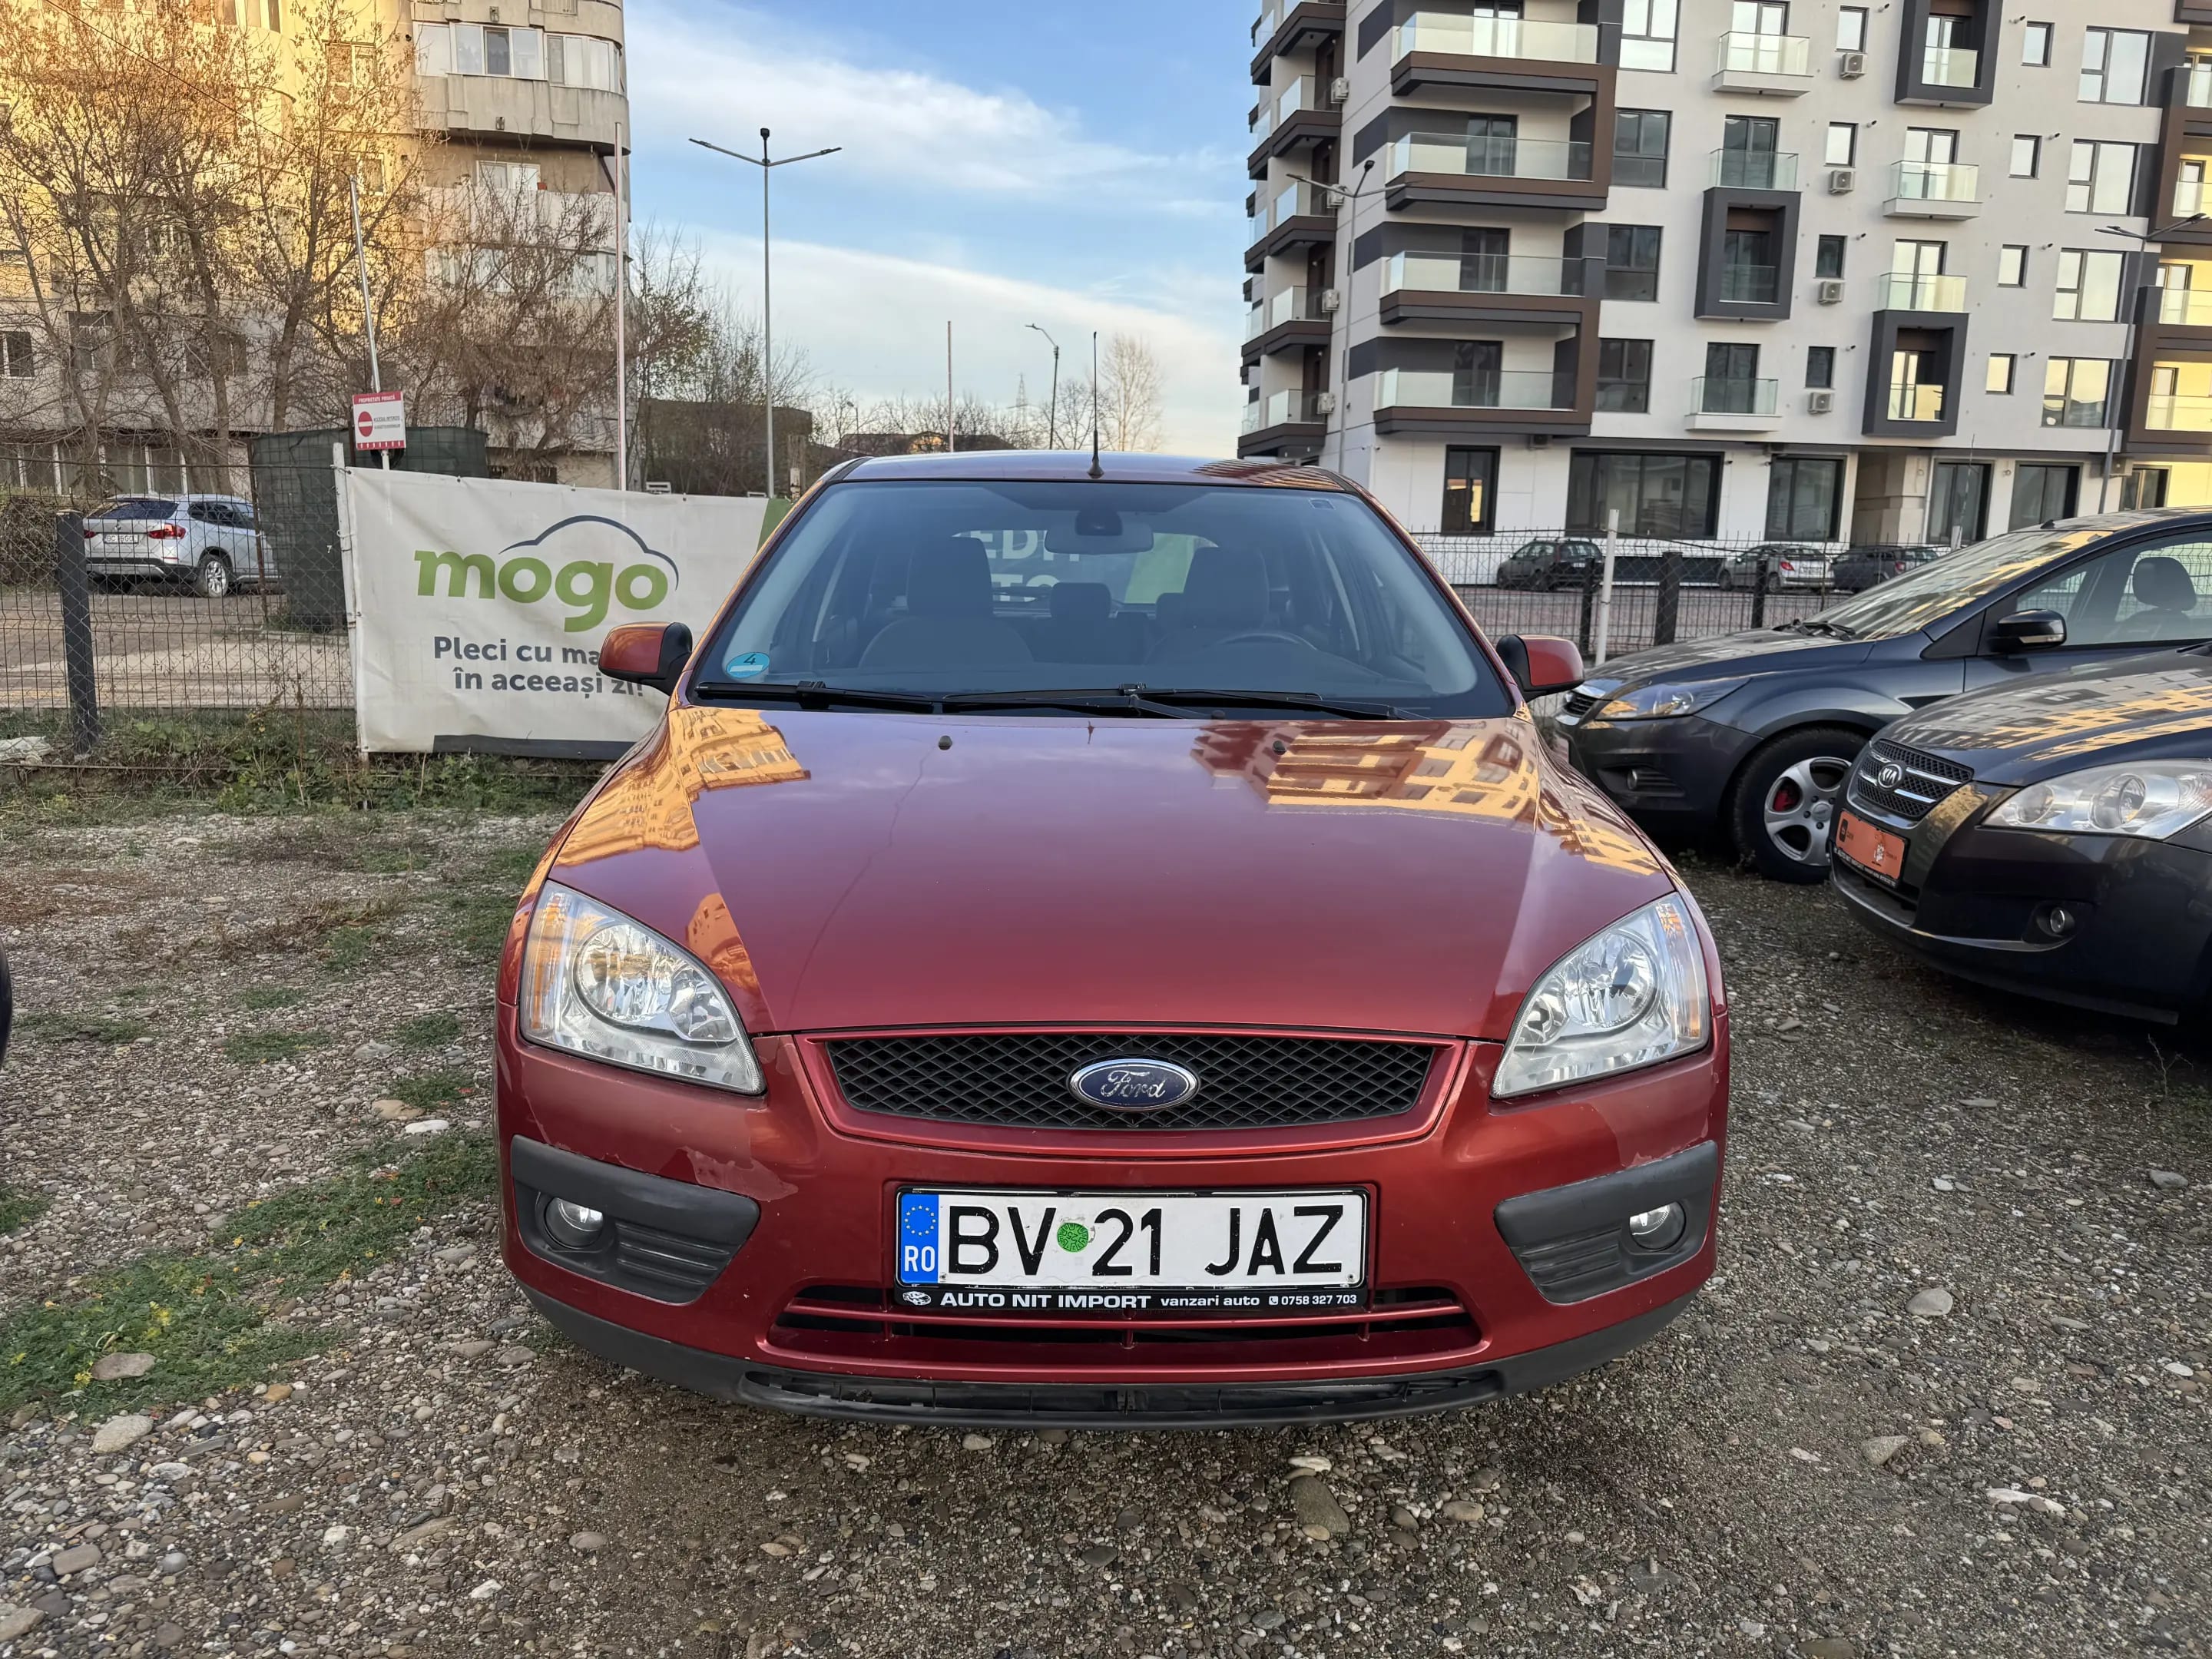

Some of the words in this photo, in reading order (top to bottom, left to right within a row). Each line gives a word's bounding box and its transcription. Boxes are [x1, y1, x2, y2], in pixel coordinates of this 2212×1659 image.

[414, 550, 668, 632] mogo
[434, 636, 507, 661] Pleci
[516, 645, 551, 663] cu
[562, 647, 600, 666] ma
[743, 653, 757, 665] 4
[452, 667, 482, 690] în
[492, 672, 603, 699] aceeași
[1100, 1069, 1167, 1098] Ford
[903, 1245, 936, 1273] RO
[948, 1205, 1057, 1276] BV
[1091, 1207, 1162, 1277] 21
[1204, 1204, 1344, 1276] JAZ
[939, 1291, 1004, 1307] AUTO
[1012, 1293, 1051, 1308] NIT
[1058, 1294, 1151, 1309] IMPORT
[1161, 1295, 1220, 1306] vanzari
[1223, 1296, 1260, 1306] auto
[1280, 1296, 1310, 1306] 0758
[1312, 1295, 1333, 1305] 327
[1336, 1295, 1357, 1304] 703
